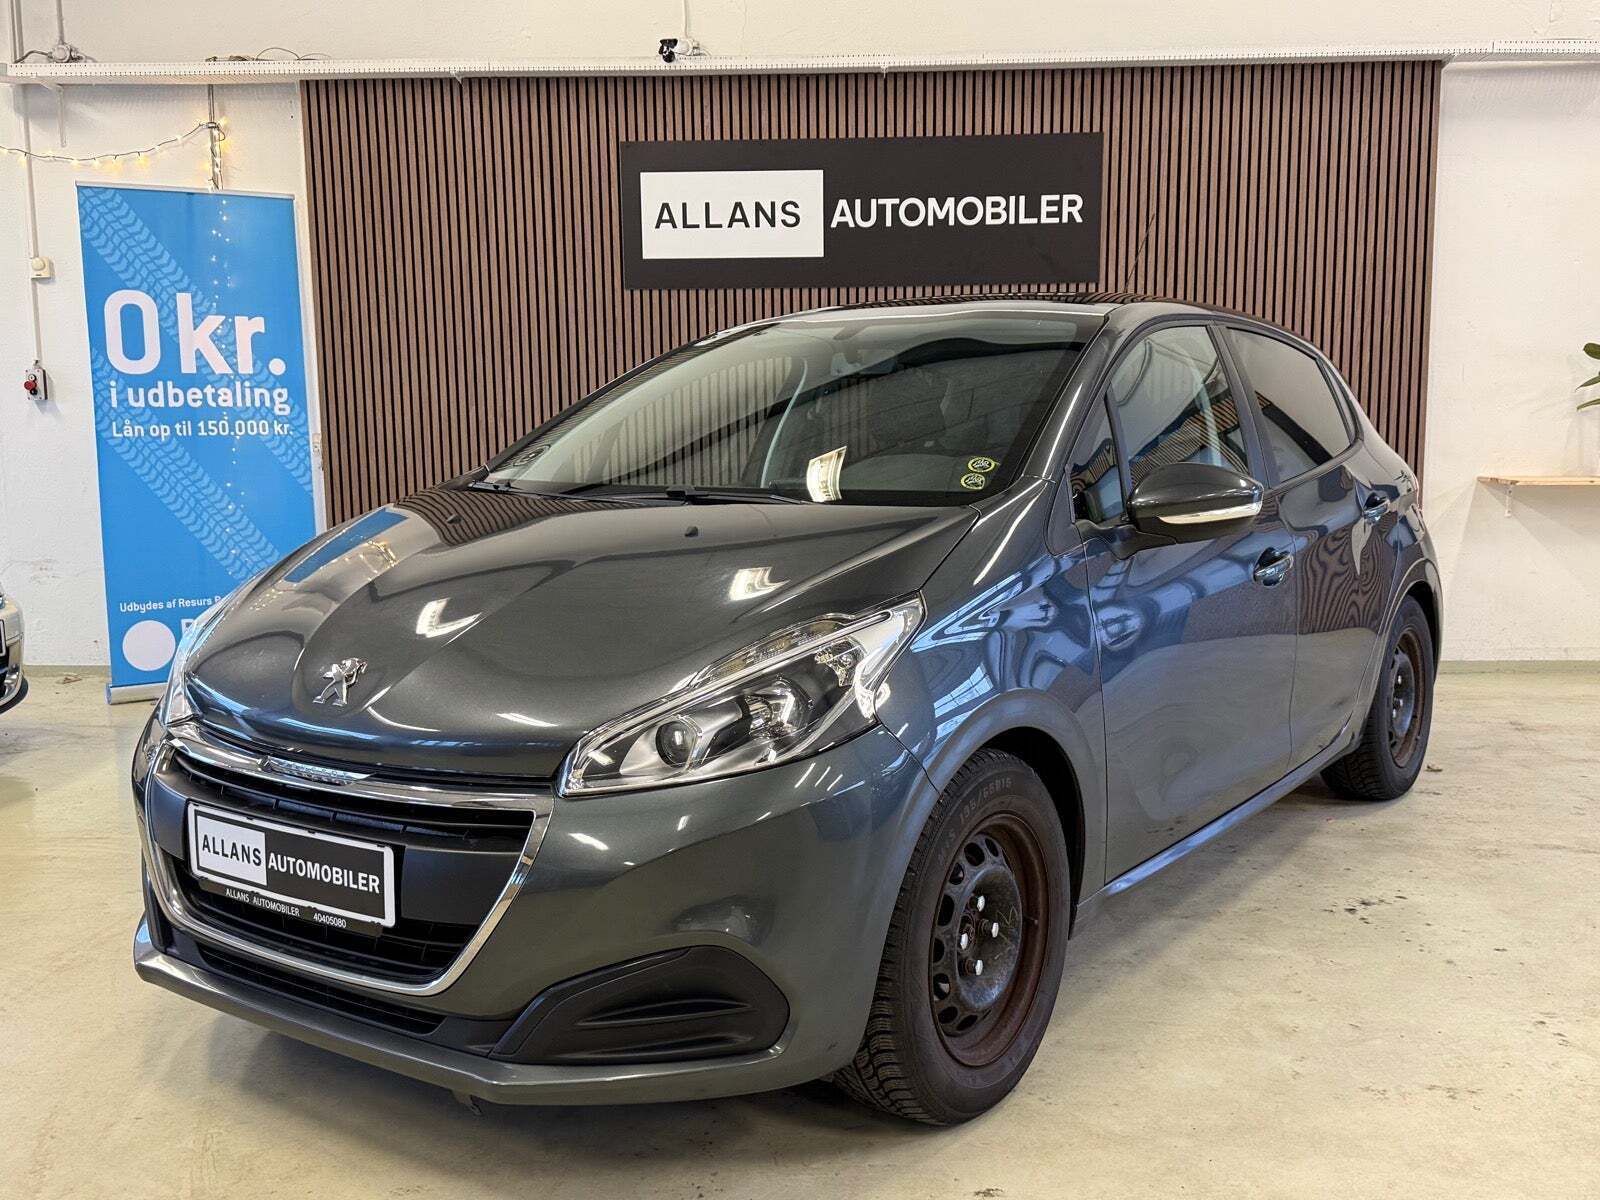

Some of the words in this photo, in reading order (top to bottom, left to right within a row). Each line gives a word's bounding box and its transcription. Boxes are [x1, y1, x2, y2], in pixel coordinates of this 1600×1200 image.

[654, 199, 802, 230] ALLANS
[829, 193, 1085, 229] AUTOMOBILER
[104, 289, 161, 375] 0
[176, 292, 287, 376] kr.
[109, 380, 118, 408] i
[127, 380, 291, 416] udbetaling
[112, 419, 145, 438] Lån
[149, 425, 171, 441] op
[175, 421, 193, 437] til
[197, 419, 270, 437] 150.000
[274, 419, 295, 436] kr.
[119, 601, 164, 614] Udbydes
[166, 599, 177, 609] af
[178, 597, 212, 608] Resurs
[202, 834, 262, 867] ALLANS
[268, 852, 380, 894] AUTOMOBILER
[225, 888, 250, 903] ALLANS
[252, 896, 300, 917] AUTOMOBILER
[313, 912, 347, 929] 40405080
